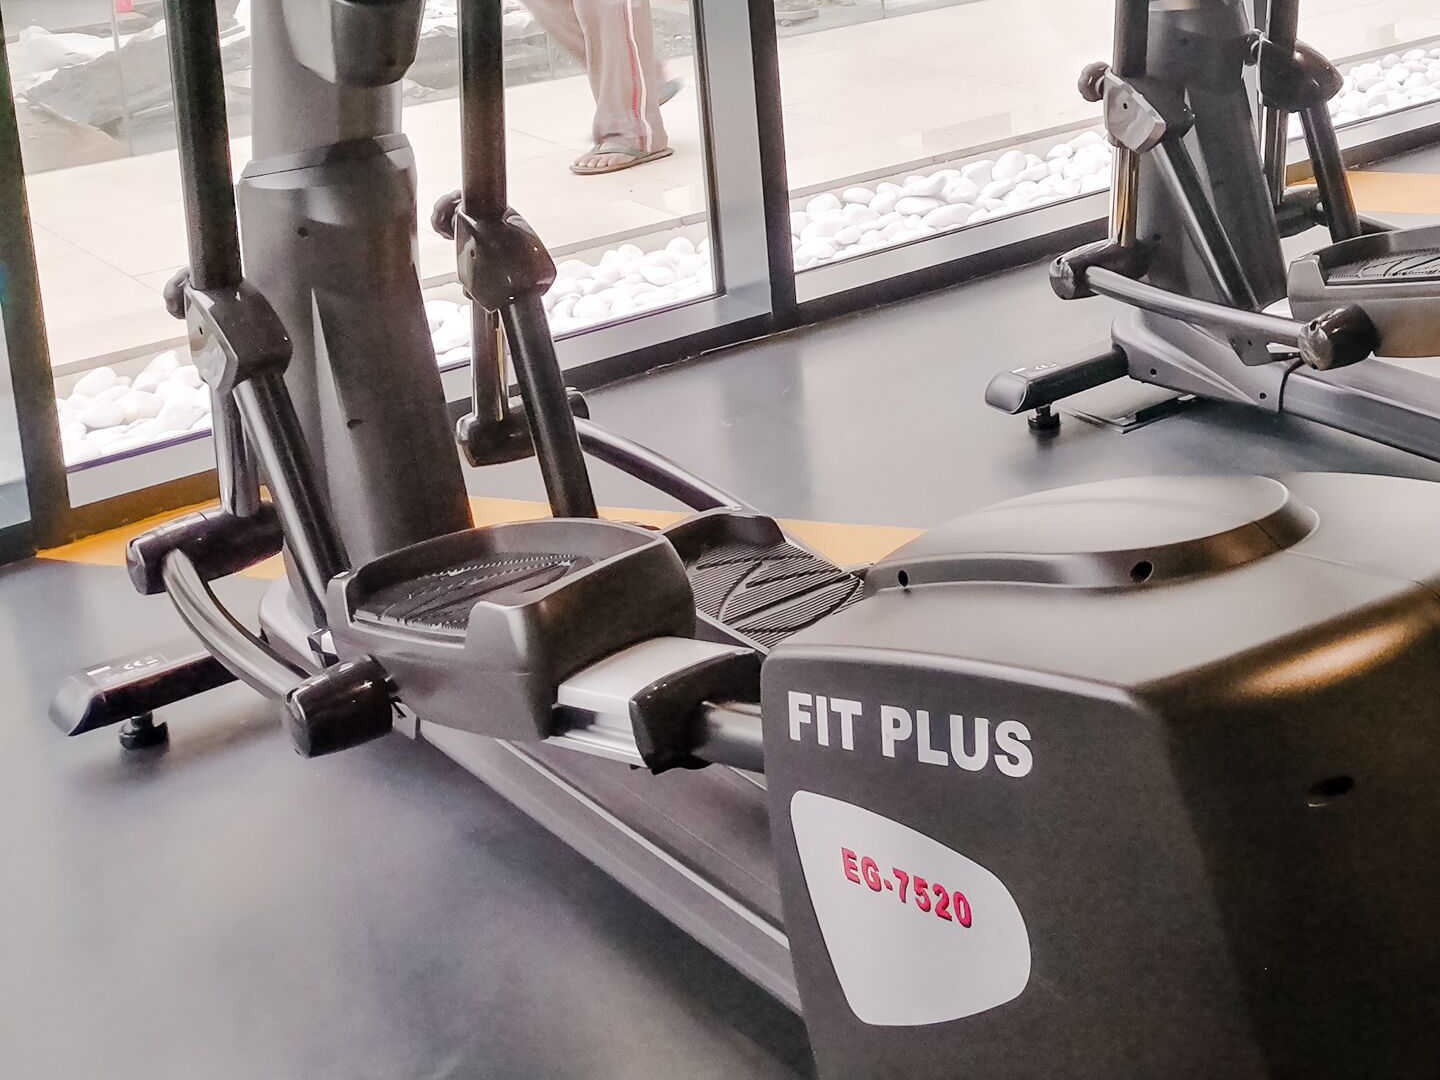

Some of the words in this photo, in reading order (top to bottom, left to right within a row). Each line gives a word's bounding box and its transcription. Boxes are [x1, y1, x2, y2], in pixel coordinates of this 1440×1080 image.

[788, 690, 863, 751] FIT
[880, 704, 1034, 779] PLUS
[841, 846, 973, 929] EG-7520
